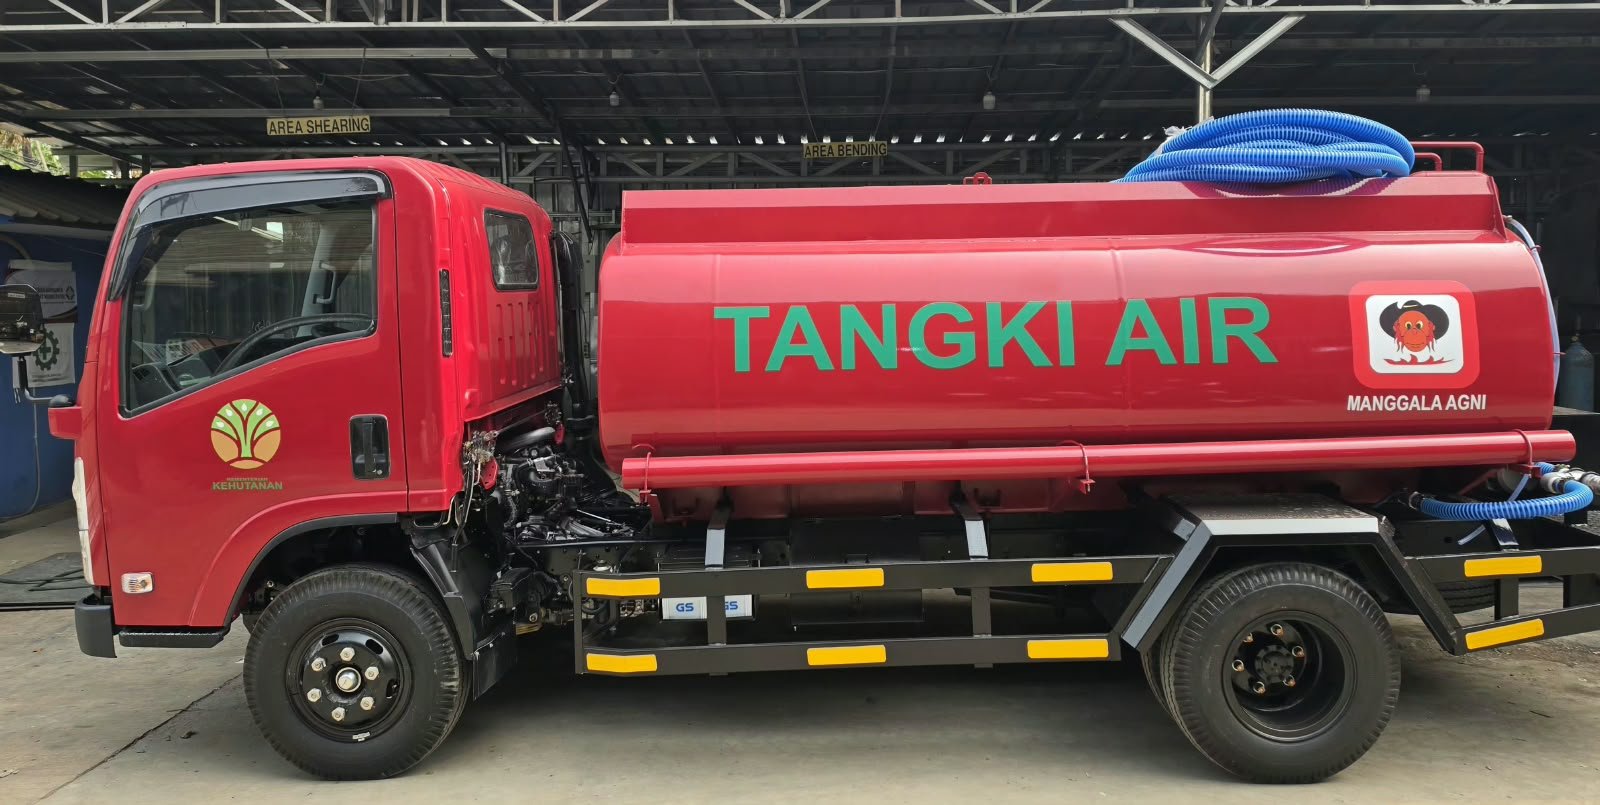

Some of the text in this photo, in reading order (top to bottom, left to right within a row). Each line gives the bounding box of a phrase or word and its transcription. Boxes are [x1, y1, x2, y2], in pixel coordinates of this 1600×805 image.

[269, 117, 370, 135] AREA SHEARING
[804, 142, 887, 158] AREA BENDING
[713, 296, 1279, 373] TANGKI AIR
[1346, 393, 1487, 412] MANGGALA AGNI
[212, 481, 283, 491] KEHUTANAN
[675, 602, 695, 612] GS
